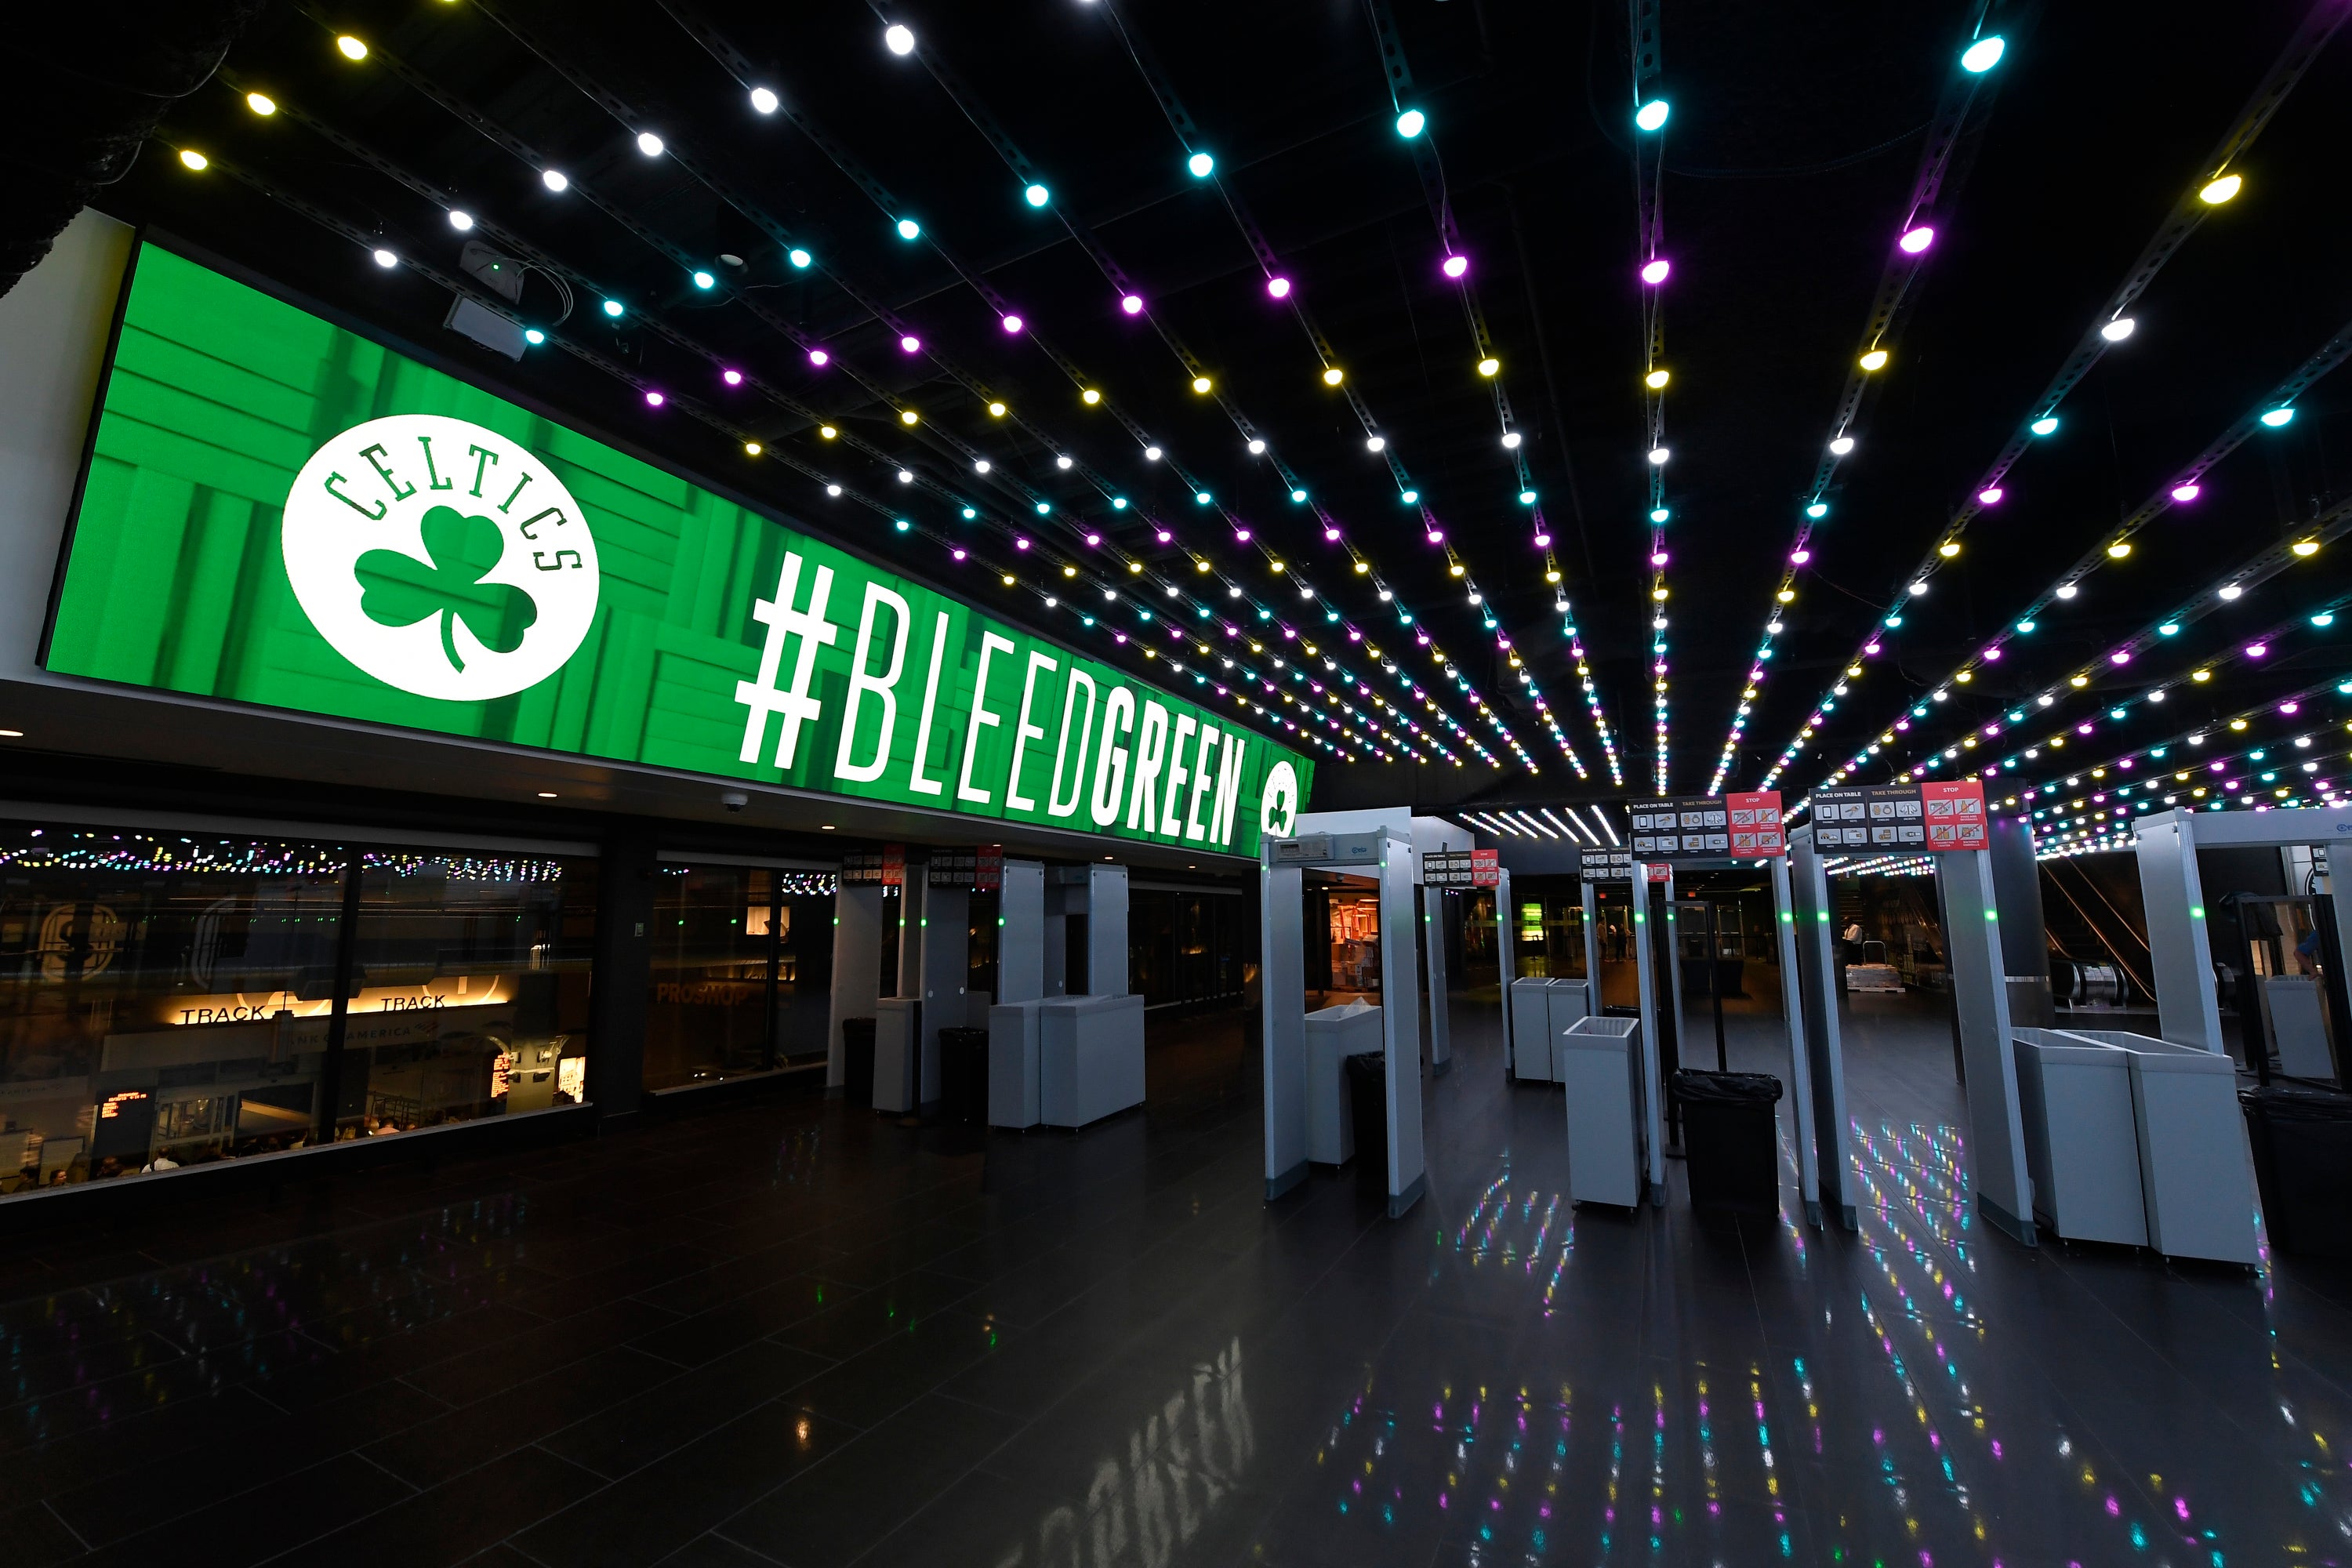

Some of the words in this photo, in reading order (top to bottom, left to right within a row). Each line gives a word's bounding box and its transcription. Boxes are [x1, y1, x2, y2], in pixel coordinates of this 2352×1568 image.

[324, 436, 583, 572] CELTICS
[734, 550, 1247, 847] #BLEEDGREEN
[381, 994, 446, 1012] TRACK
[180, 1005, 266, 1025] TRACK
[345, 1028, 411, 1041] AMERICA
